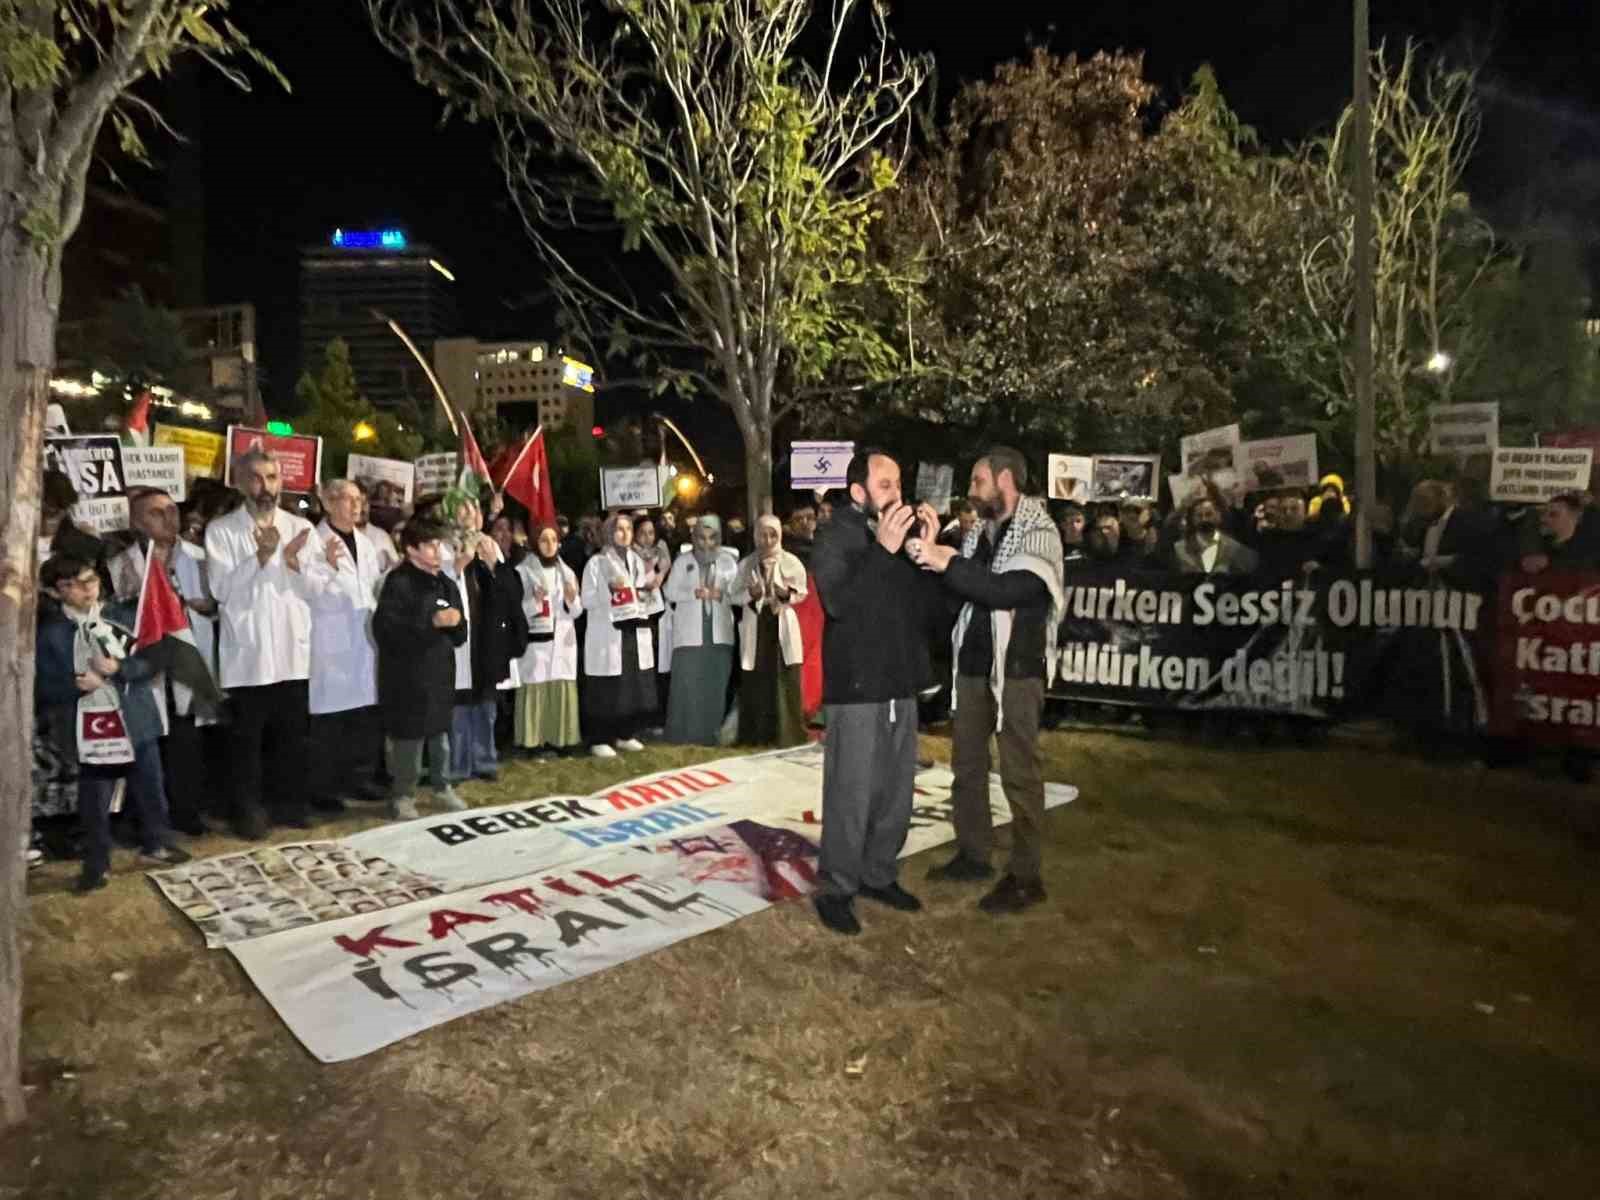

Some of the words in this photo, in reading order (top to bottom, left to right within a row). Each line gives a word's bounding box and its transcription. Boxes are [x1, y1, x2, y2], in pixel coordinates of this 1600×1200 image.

[1192, 580, 1317, 627] Sessiz
[1328, 579, 1483, 631] Olunur
[426, 799, 604, 847] BEBEK
